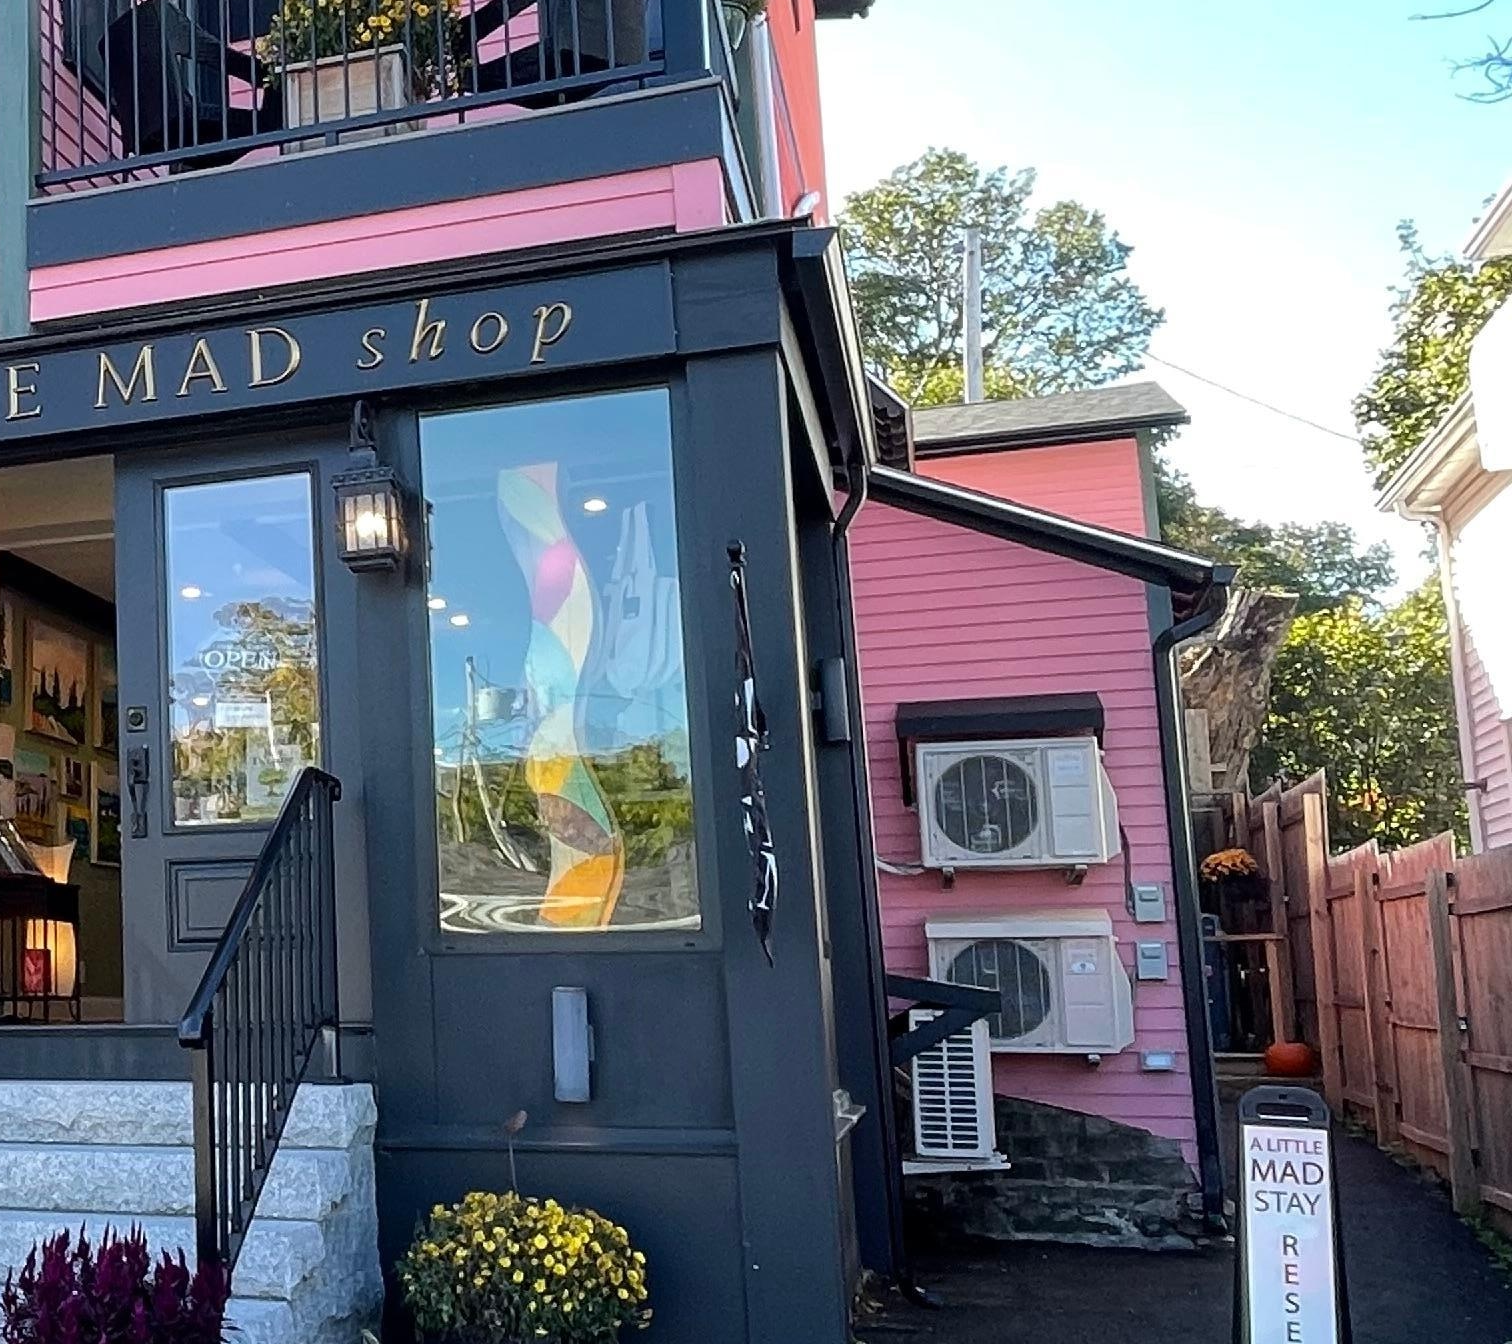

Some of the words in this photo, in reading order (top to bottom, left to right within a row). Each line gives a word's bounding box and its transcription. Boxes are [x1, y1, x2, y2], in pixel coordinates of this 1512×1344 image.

[92, 326, 303, 410] MAD
[355, 297, 573, 371] shop
[204, 649, 277, 670] OPEN
[1249, 1137, 1263, 1152] A
[1266, 1138, 1323, 1155] LITTLE
[1250, 1158, 1324, 1186] MAD
[1254, 1190, 1322, 1216] STAY
